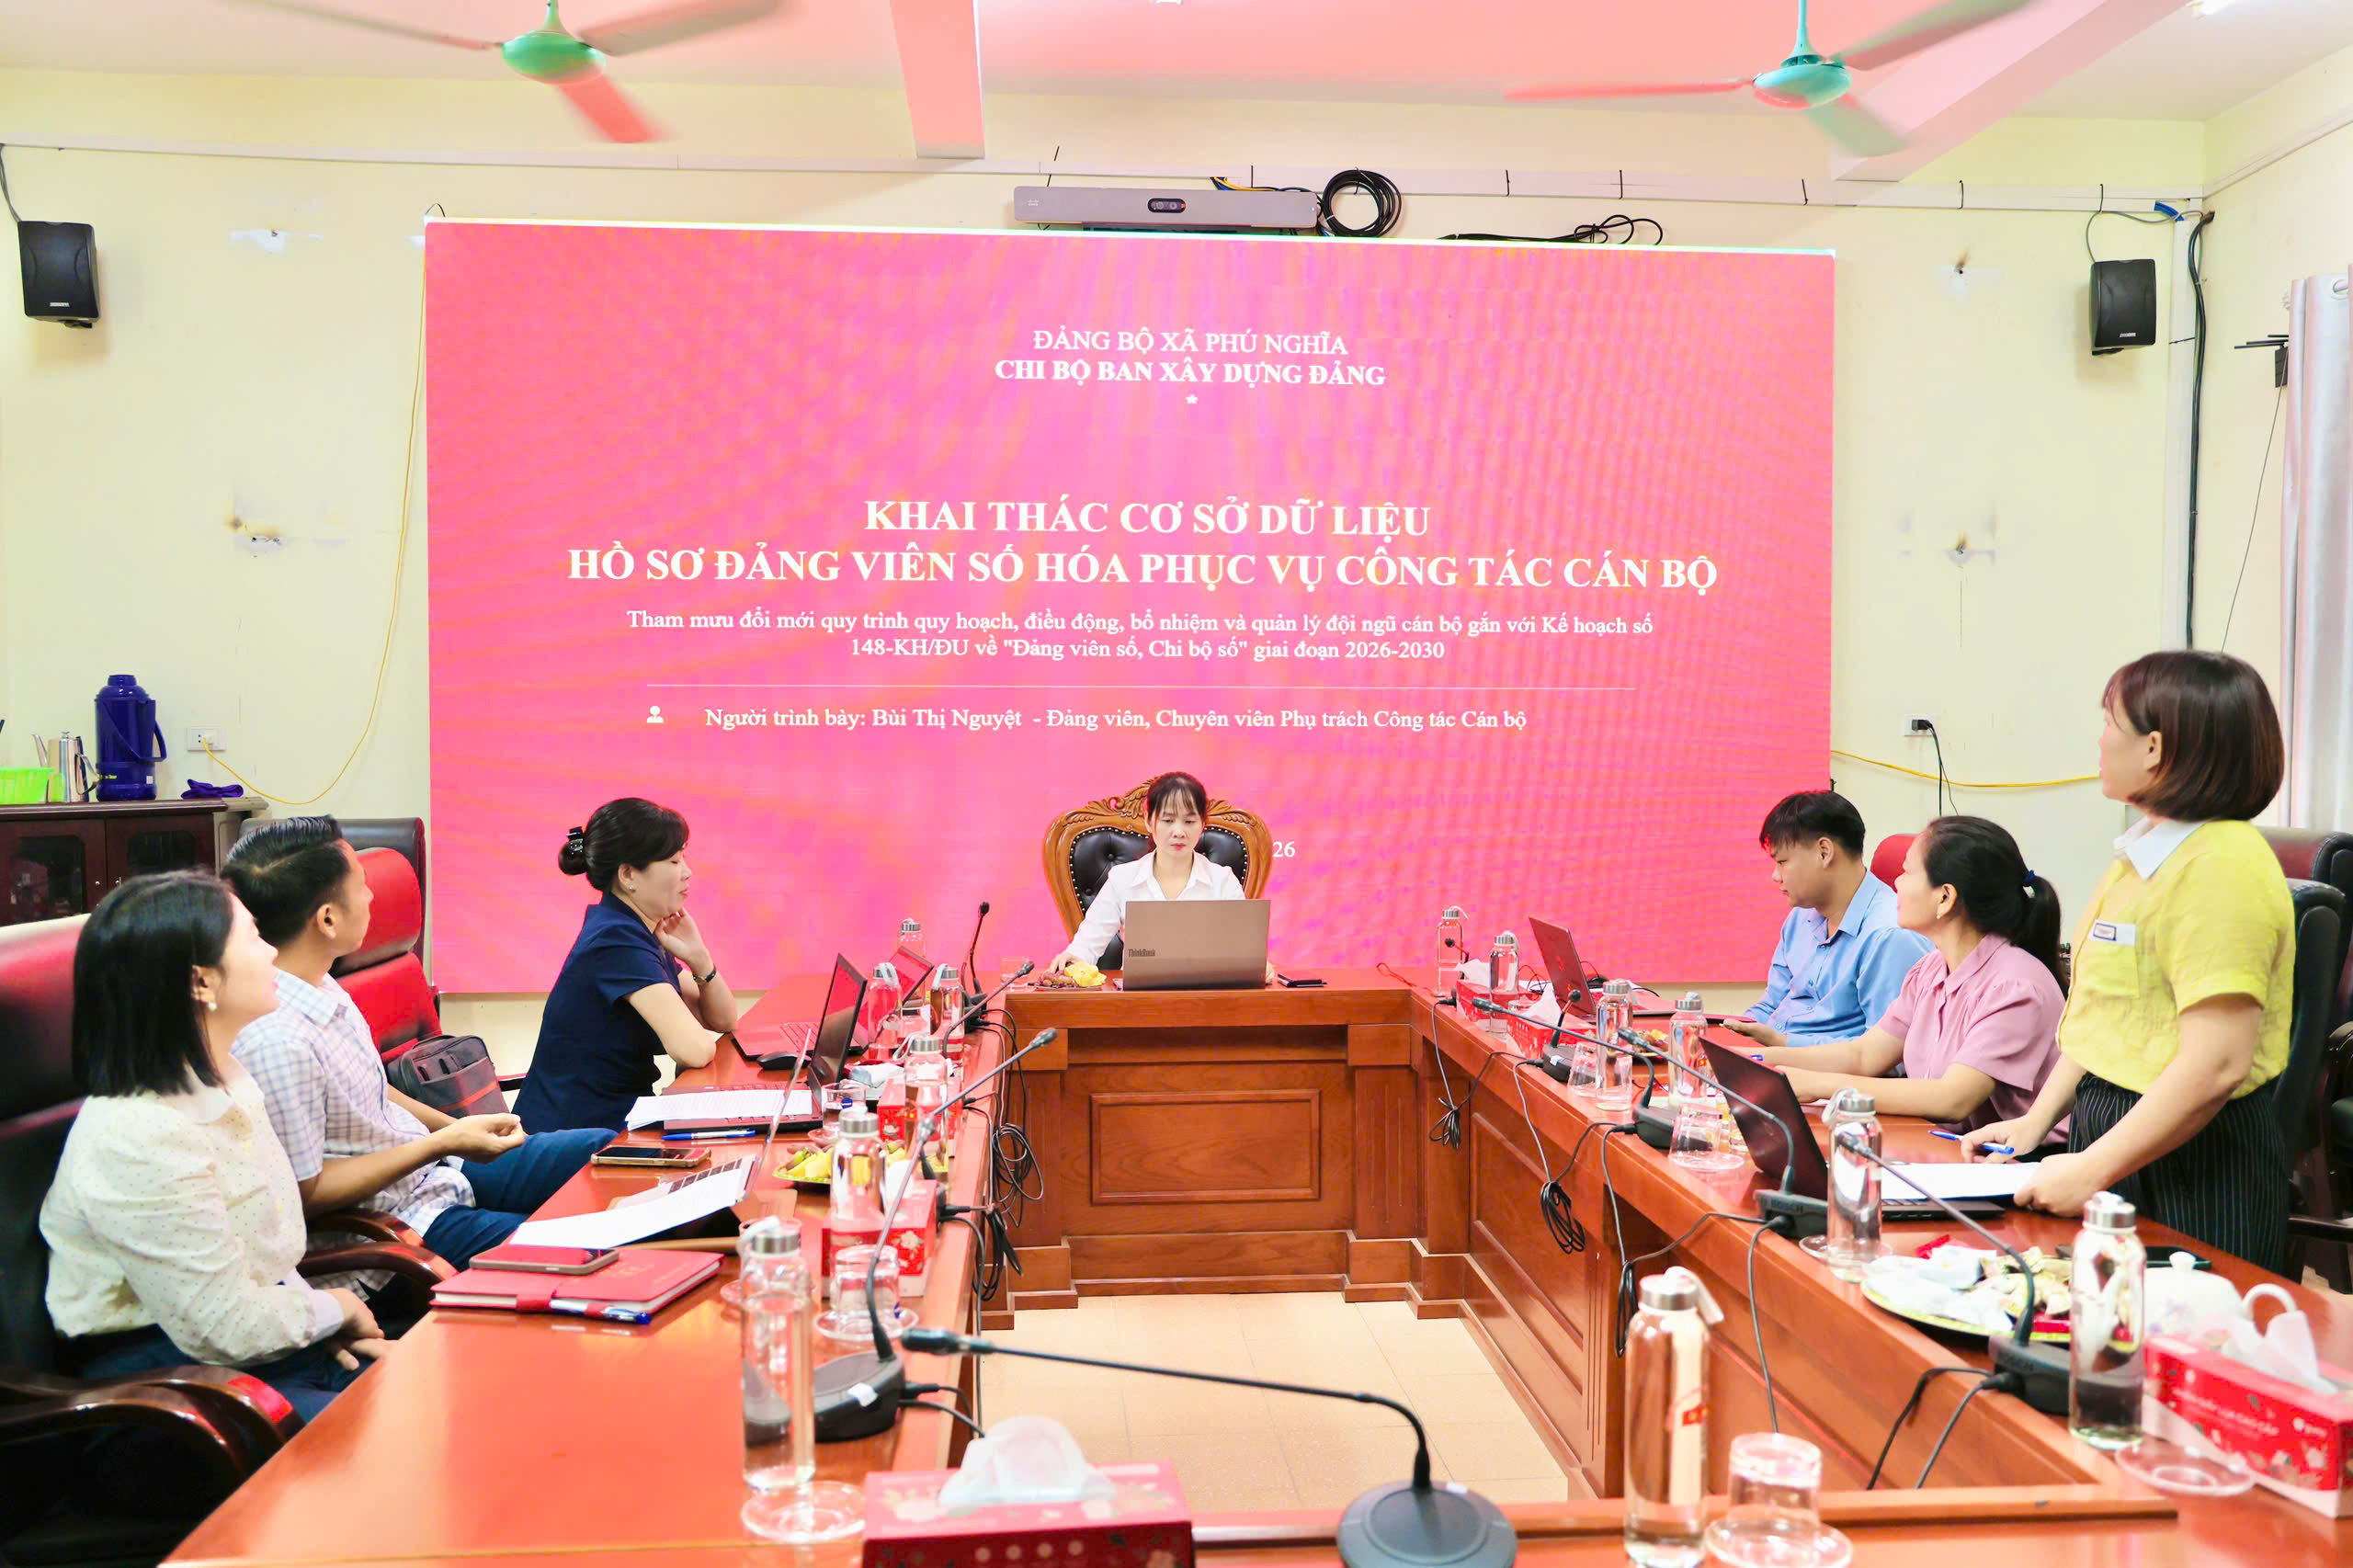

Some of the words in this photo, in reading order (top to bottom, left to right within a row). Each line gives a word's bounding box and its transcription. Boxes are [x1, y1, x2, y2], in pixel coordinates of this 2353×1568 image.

[1033, 324, 1111, 350] ĐẢNG
[1117, 325, 1154, 355] BỘ
[1160, 327, 1199, 352] XÃ
[1205, 328, 1258, 353] PHÚ
[1264, 330, 1348, 355] NGHĨA
[995, 359, 1045, 380] CHI
[1052, 358, 1091, 386] BỘ
[1097, 361, 1154, 381] BAN
[1159, 358, 1217, 383] XÂY
[1223, 360, 1302, 389] DỰNG
[1308, 361, 1386, 386] ĐẢNG
[865, 500, 976, 530] KHAI
[987, 494, 1108, 532] THÁC
[1120, 501, 1184, 533] CƠ
[1193, 495, 1250, 534] SỞ
[1258, 497, 1324, 535] DỮ
[1332, 502, 1431, 543] LIỆU
[568, 540, 635, 580] HỒ
[646, 547, 705, 580] SƠ
[714, 541, 840, 581] ĐẢNG
[850, 541, 957, 582] VIÊN
[969, 543, 1024, 583] SỐ
[1035, 544, 1131, 583] HÓA
[1139, 554, 1256, 592] PHỤC
[1267, 555, 1324, 593] VỤ
[1336, 546, 1459, 586] CÔNG
[1468, 549, 1552, 587] TÁC
[1563, 550, 1650, 587] CÁN
[1661, 555, 1718, 597] BỘ
[626, 609, 685, 628] Tham
[689, 616, 734, 628] mưu
[739, 606, 771, 628] đổi
[777, 610, 815, 629] mới
[821, 616, 858, 633] quy
[863, 611, 909, 629] trình
[914, 617, 950, 634] quy
[955, 611, 1019, 634] hoạch,
[1024, 608, 1066, 630] điều
[1071, 612, 1124, 635] động,
[1130, 608, 1154, 631] bổ
[1160, 613, 1219, 633] nhiệm
[1223, 614, 1247, 632] và
[1251, 613, 1298, 636] quản
[1303, 614, 1322, 636] lý
[1325, 614, 1356, 635] đội
[1361, 615, 1396, 637] ngũ
[1402, 615, 1434, 632] cán
[1438, 615, 1462, 636] bộ
[1467, 611, 1501, 637] gắn
[1506, 616, 1536, 633] với
[1541, 611, 1569, 633] Kế
[1573, 617, 1628, 637] hoạch
[1632, 612, 1654, 633] số
[852, 638, 970, 655] 148-KH/ĐU
[974, 634, 997, 656] về
[1004, 639, 1064, 661] "Đảng
[1069, 639, 1111, 657] viên
[1116, 635, 1143, 660] số,
[1148, 639, 1183, 657] Chi
[1188, 639, 1212, 661] bộ
[1218, 635, 1247, 657] số"
[1253, 640, 1289, 663] giai
[1293, 641, 1340, 661] đoạn
[1345, 641, 1445, 658] 2026-2030
[705, 708, 767, 731] Người
[773, 709, 819, 726] trình
[824, 709, 865, 731] bày:
[871, 709, 906, 726] Bùi
[913, 709, 946, 729] Thị
[951, 709, 1022, 731] Nguyệt
[1047, 709, 1098, 732] Đảng
[1104, 709, 1151, 729] viên,
[1155, 709, 1229, 732] Chuyên
[1234, 709, 1275, 727] viên
[1280, 710, 1317, 730] Phụ
[1322, 710, 1369, 727] trách
[1373, 710, 1424, 732] Công
[1429, 710, 1456, 727] tác
[1461, 710, 1498, 727] Cán
[1503, 710, 1527, 731] bộ
